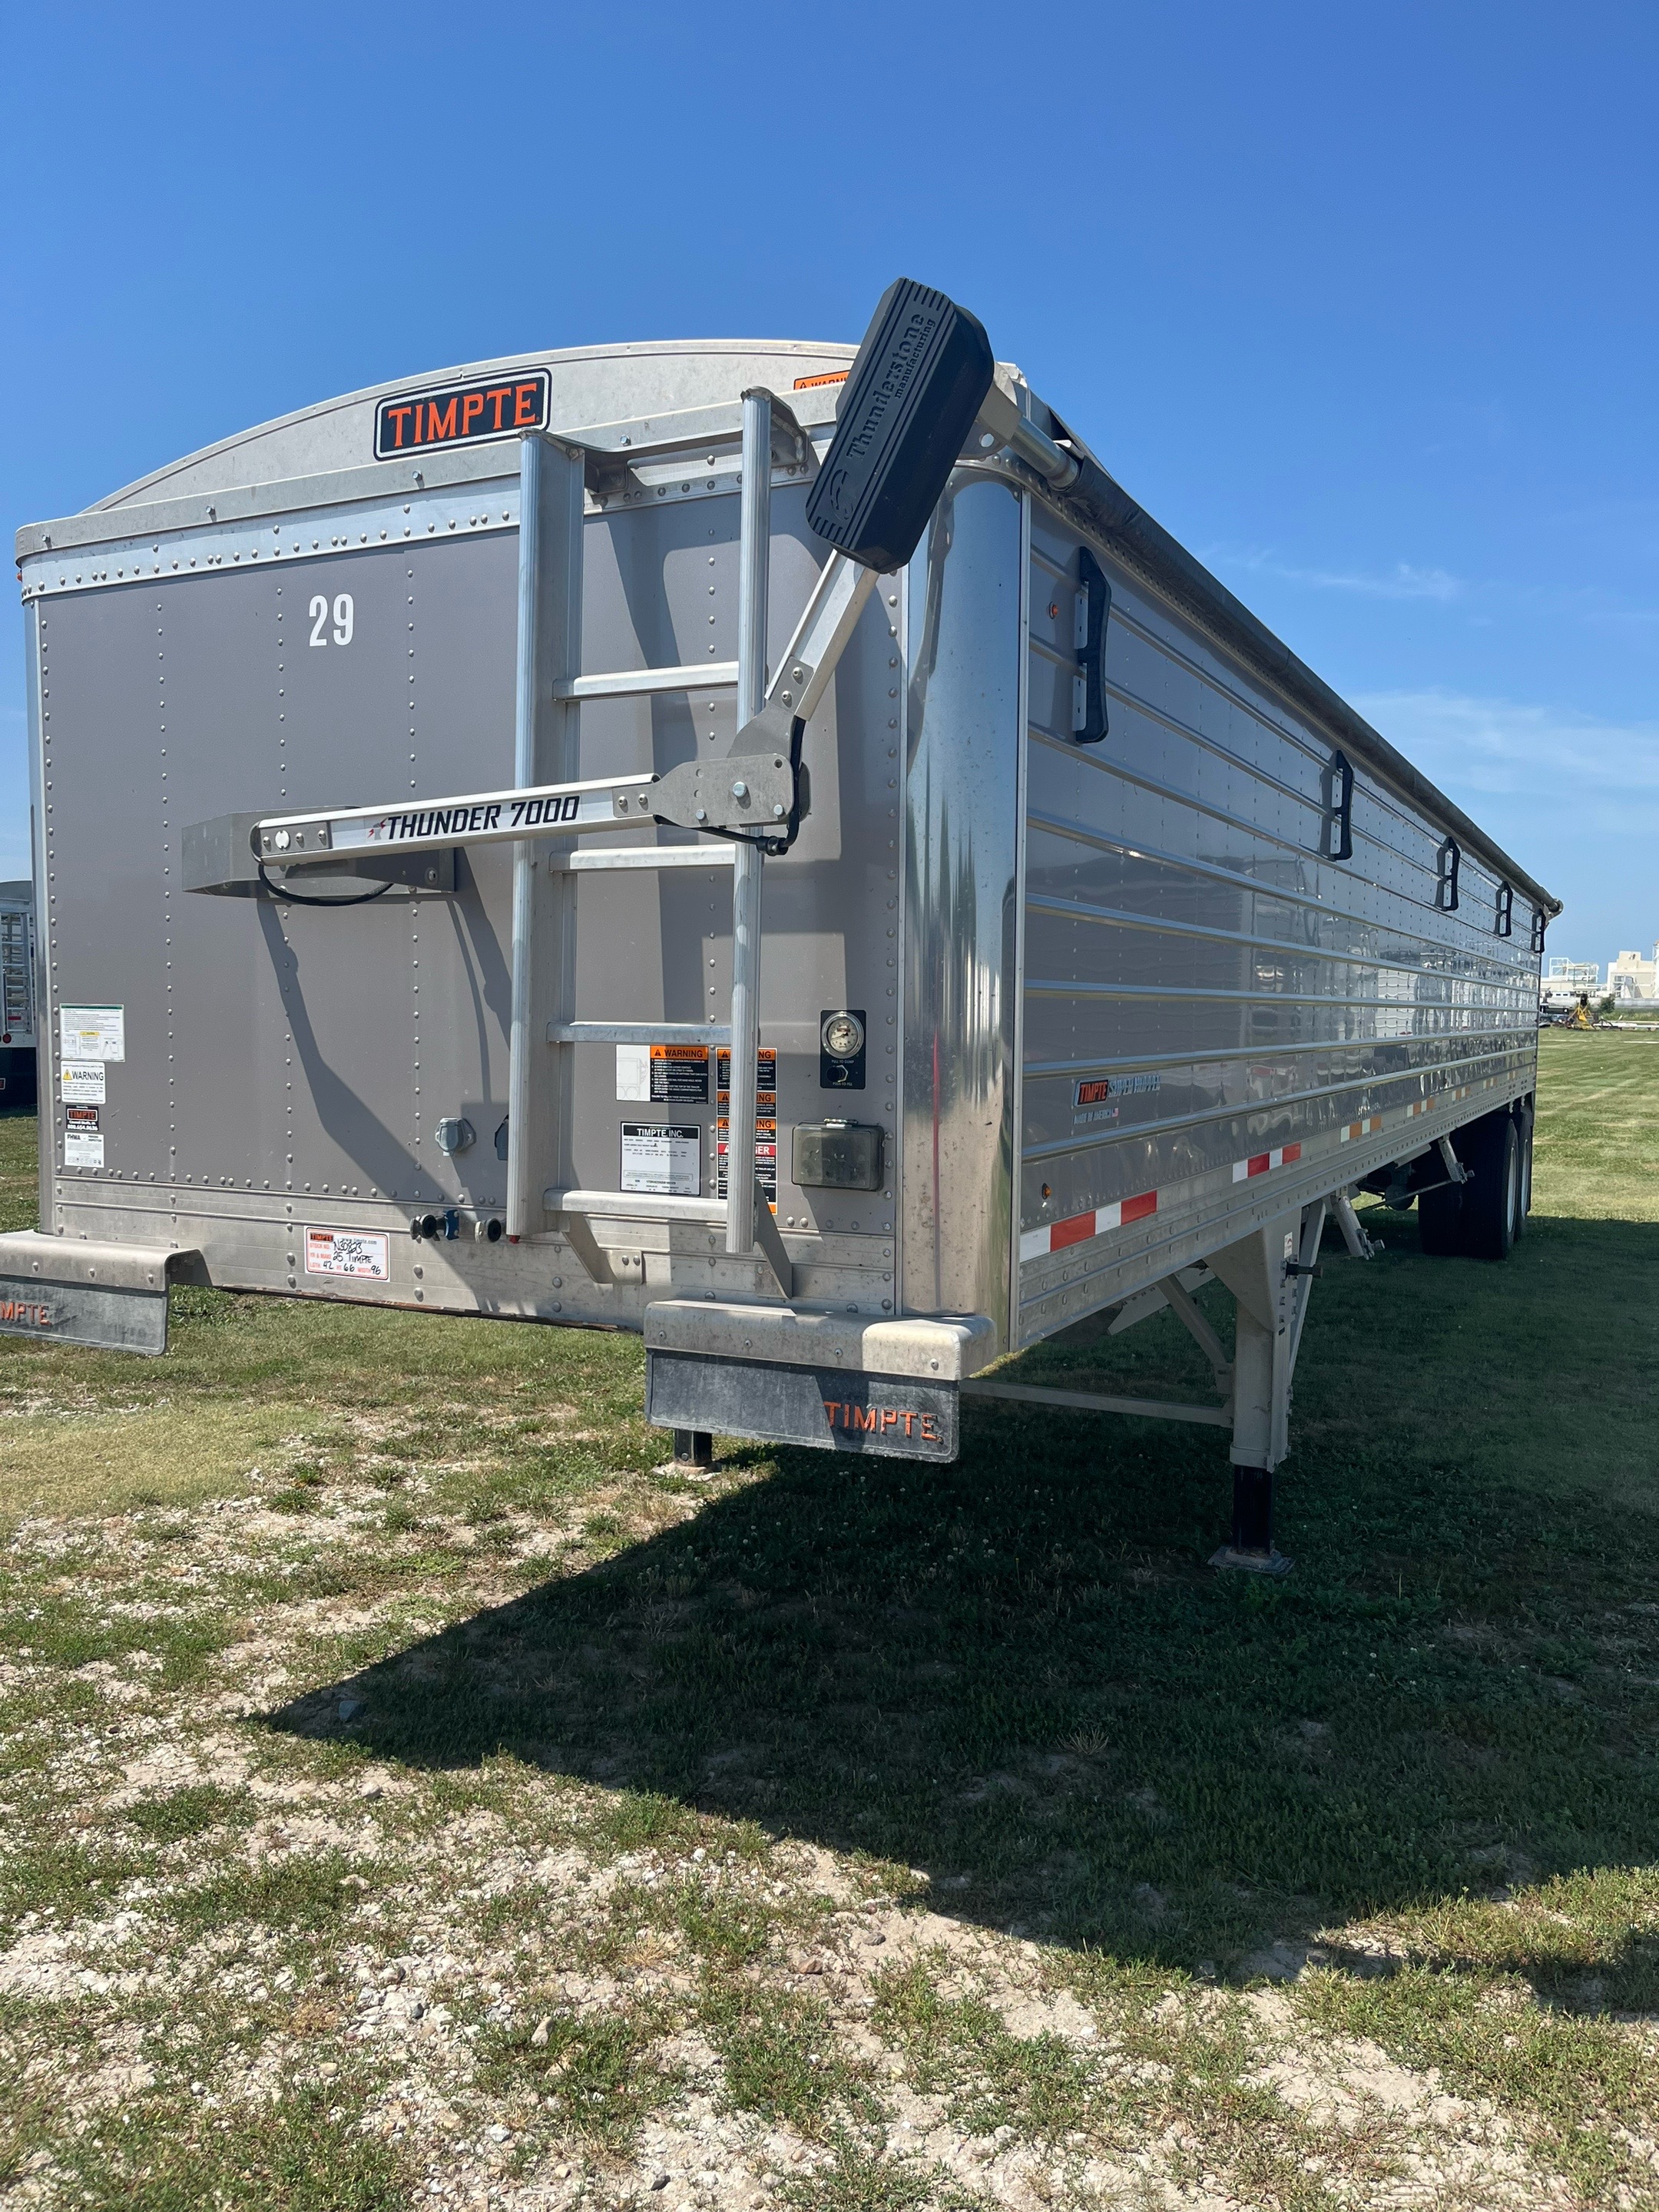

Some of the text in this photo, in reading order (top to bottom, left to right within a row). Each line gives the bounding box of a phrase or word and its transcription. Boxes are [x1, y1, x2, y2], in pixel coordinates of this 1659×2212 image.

[894, 318, 936, 399] manufacturing
[388, 382, 537, 447] TIMPTE
[309, 593, 354, 647] 29
[387, 796, 580, 839] THUNDER 7000
[664, 1049, 703, 1058] WARNING
[72, 1071, 104, 1081] WARNING
[1080, 1082, 1108, 1102] TIMPTE
[69, 1111, 96, 1119] TIMPTE
[637, 1128, 684, 1138] TIMPTE INC.
[333, 1251, 343, 1262] 25
[323, 1260, 334, 1270] 42
[343, 1263, 355, 1272] 66
[370, 1265, 381, 1275] 96
[0, 1301, 50, 1326] MPTE
[823, 1400, 939, 1442] TIMPTE
